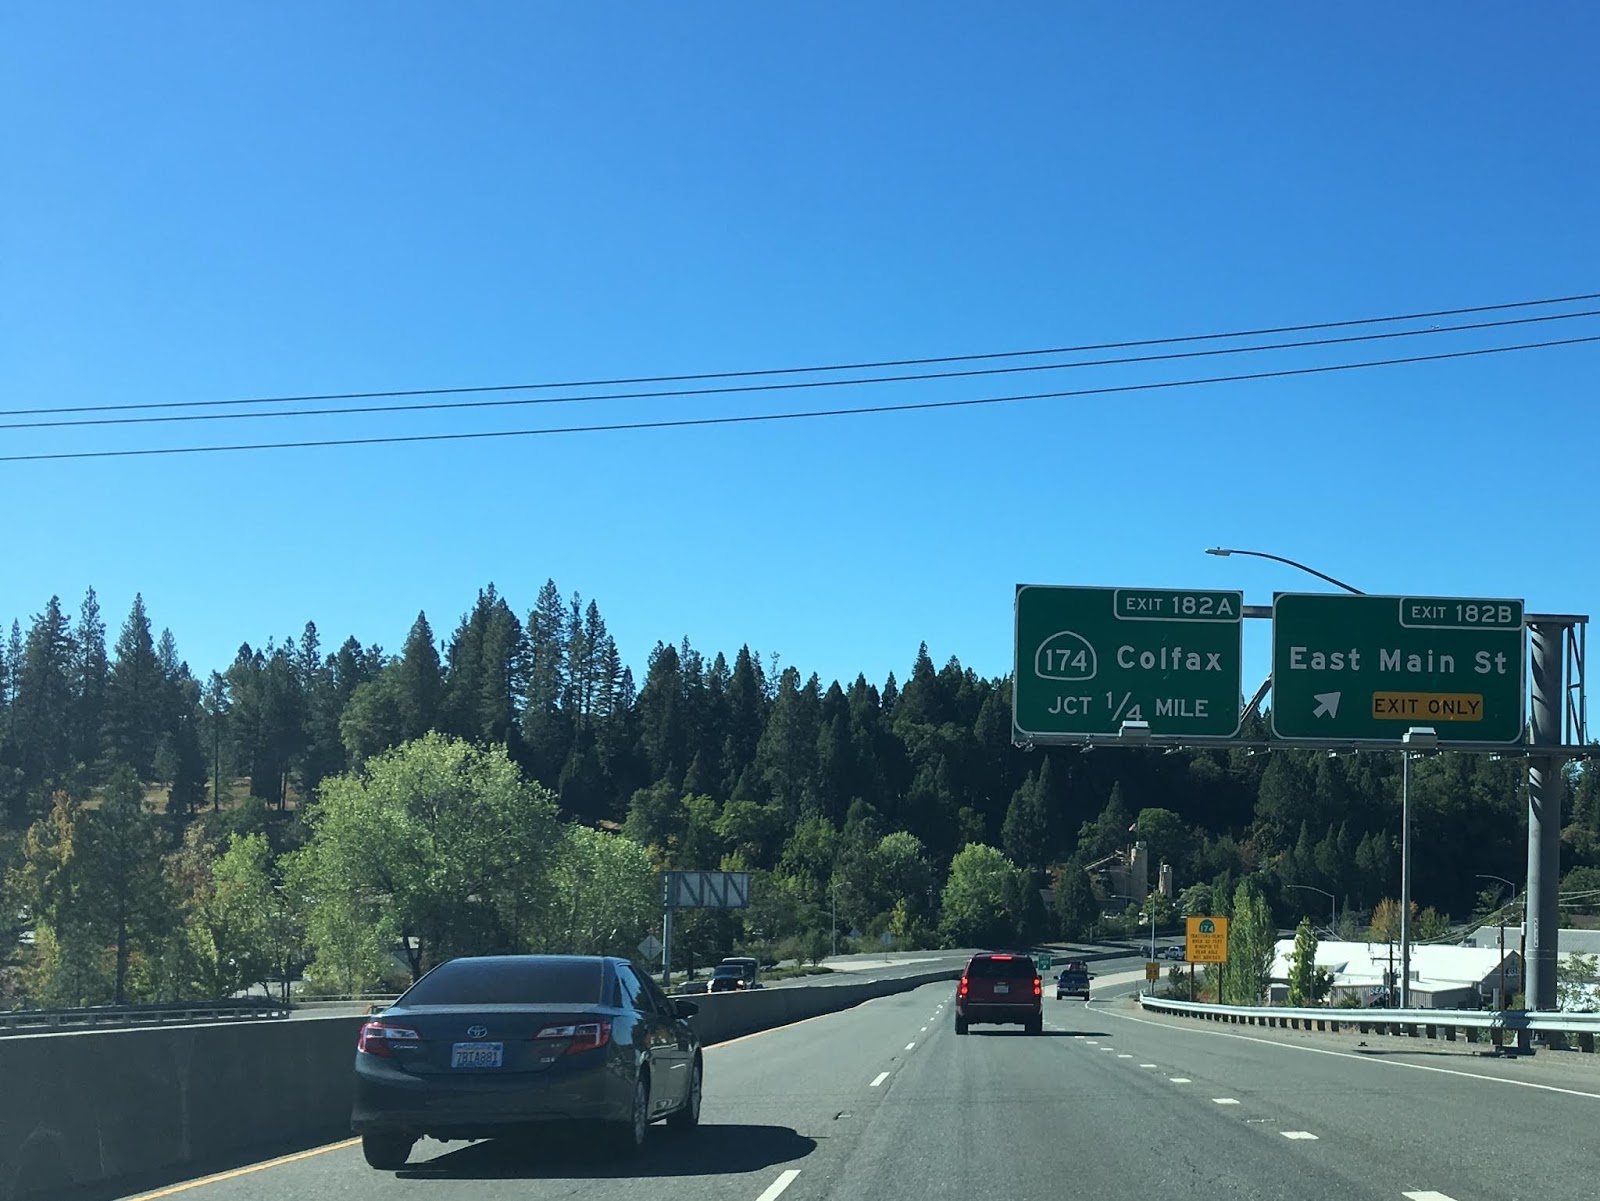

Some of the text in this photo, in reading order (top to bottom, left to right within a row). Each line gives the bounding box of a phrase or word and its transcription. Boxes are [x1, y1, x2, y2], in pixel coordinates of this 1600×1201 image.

[1126, 596, 1234, 616] EXIT 182A
[1411, 604, 1512, 623] EXIT 182B
[1045, 645, 1222, 672] 174 Colfax
[1289, 646, 1507, 674] East Main St
[1047, 691, 1209, 721] JCT 1/4 MILE
[1374, 698, 1481, 715] EXIT ONLY
